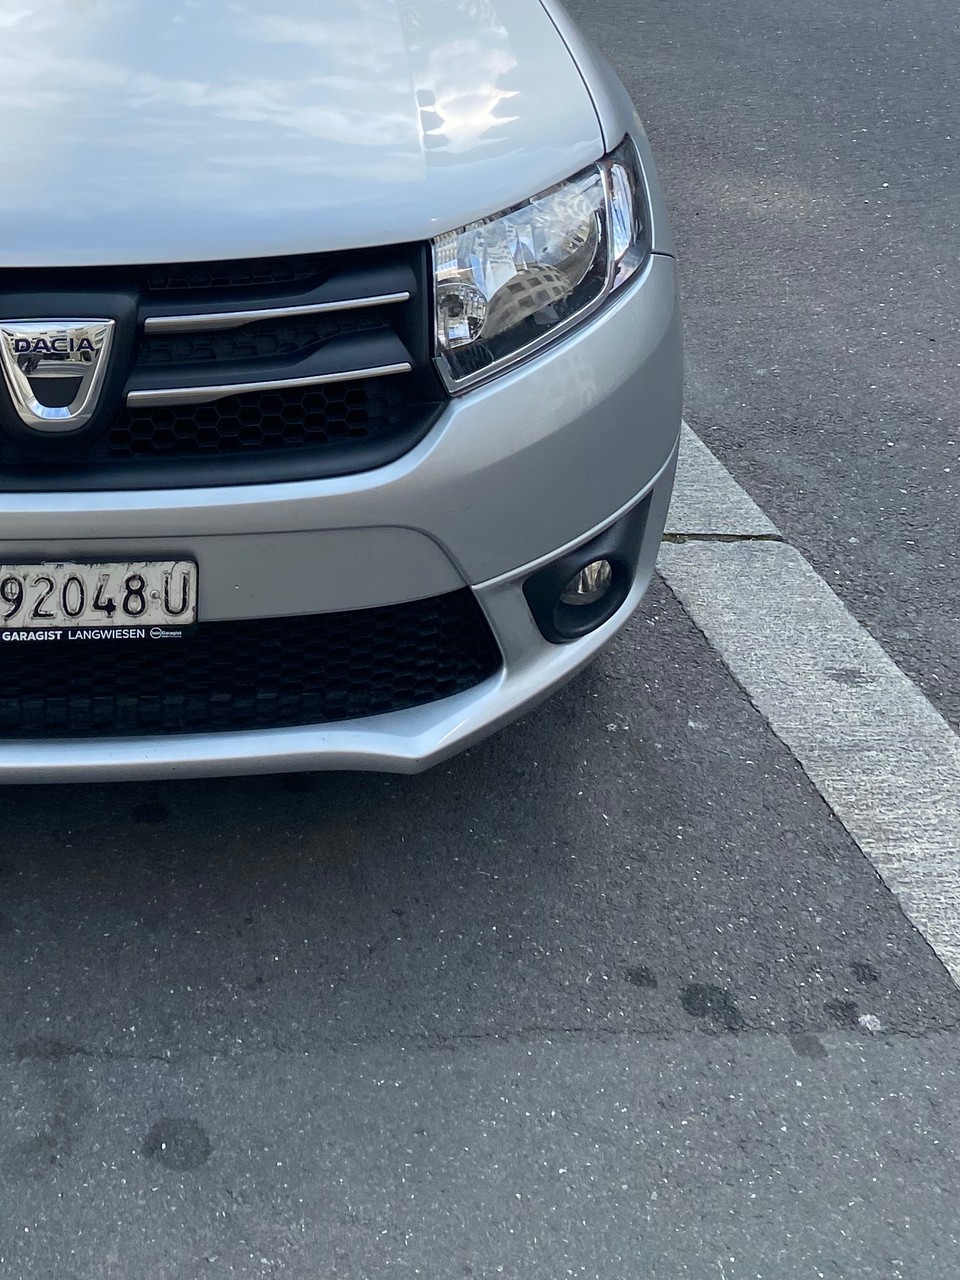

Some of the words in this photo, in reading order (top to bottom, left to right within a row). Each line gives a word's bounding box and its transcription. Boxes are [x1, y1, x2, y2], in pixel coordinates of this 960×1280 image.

[14, 338, 95, 353] DACIA
[2, 630, 63, 641] GARAGIST
[68, 628, 145, 640] LANGWIESEN
